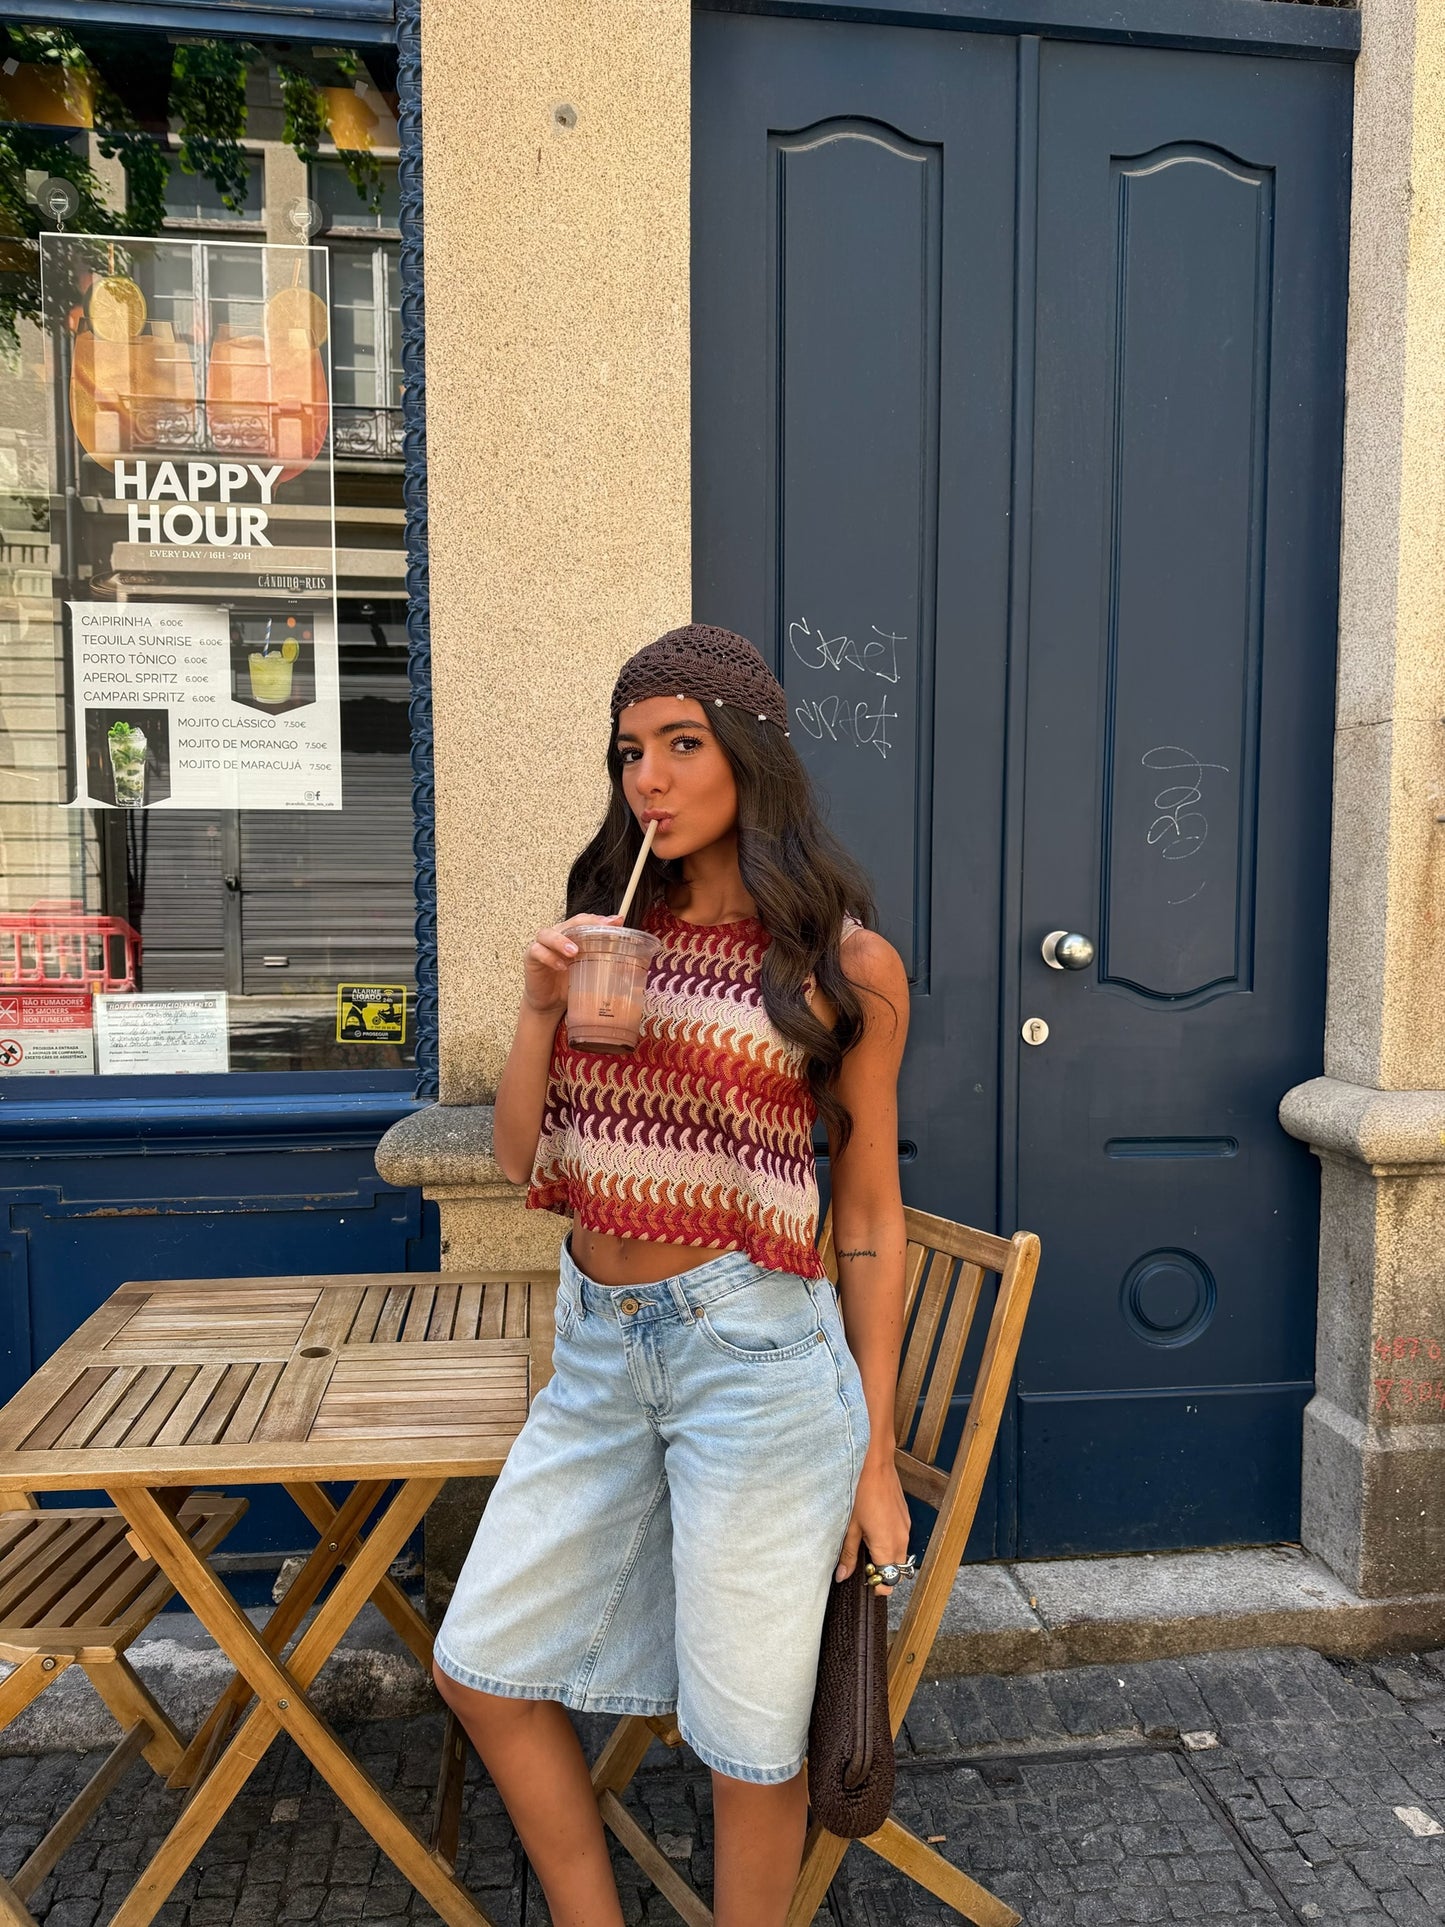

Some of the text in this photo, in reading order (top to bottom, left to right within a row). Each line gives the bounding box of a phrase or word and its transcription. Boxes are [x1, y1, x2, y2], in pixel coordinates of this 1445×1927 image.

[114, 460, 284, 504] HAPPY
[128, 503, 274, 547] HOUR
[150, 550, 181, 558] EVERY
[183, 550, 202, 559] DAY
[233, 552, 251, 560] 20H
[305, 577, 326, 590] REIS
[81, 616, 152, 627] CAIPIRINHA
[82, 635, 136, 646] TEQUILA
[138, 636, 192, 646] SUNRISE
[82, 653, 126, 664] PORTO
[82, 672, 133, 683] APEROL
[135, 673, 178, 684] SPRITZ
[83, 691, 139, 702] CAMPARI
[142, 692, 185, 702] SPRITZ
[177, 718, 219, 728] MOJITO
[222, 717, 276, 728] CLÁSSICO
[178, 739, 220, 749] MOJITO
[222, 739, 237, 749] DE
[240, 740, 298, 750] MORANGO
[179, 760, 332, 771] MOJITO DE MARACUJÁ 7.50€
[109, 1001, 141, 1010] HORÁRIO
[152, 1001, 214, 1009] FUNCIONAMENTO
